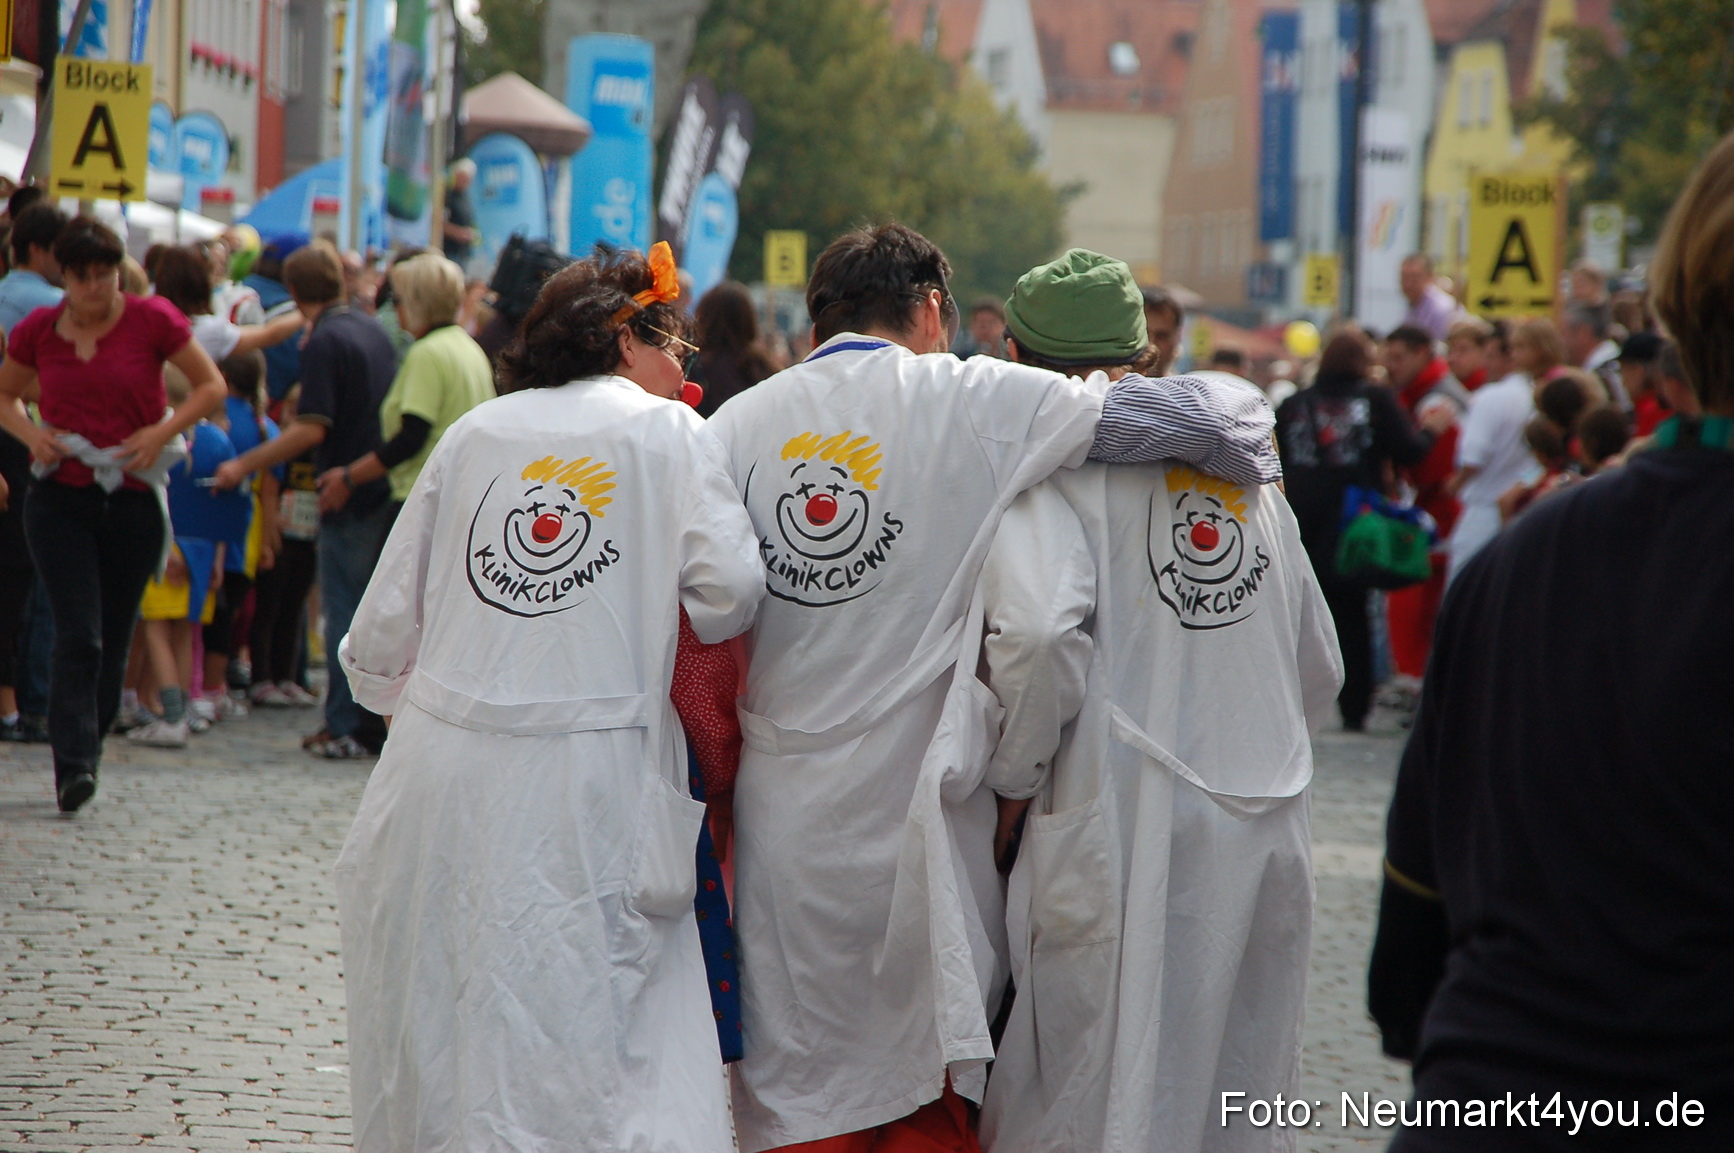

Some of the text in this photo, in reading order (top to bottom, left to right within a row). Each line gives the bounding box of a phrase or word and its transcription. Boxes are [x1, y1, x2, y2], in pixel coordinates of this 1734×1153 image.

[65, 61, 140, 92] Block
[71, 102, 126, 170] A
[1481, 177, 1557, 207] Block
[1488, 218, 1543, 284] A
